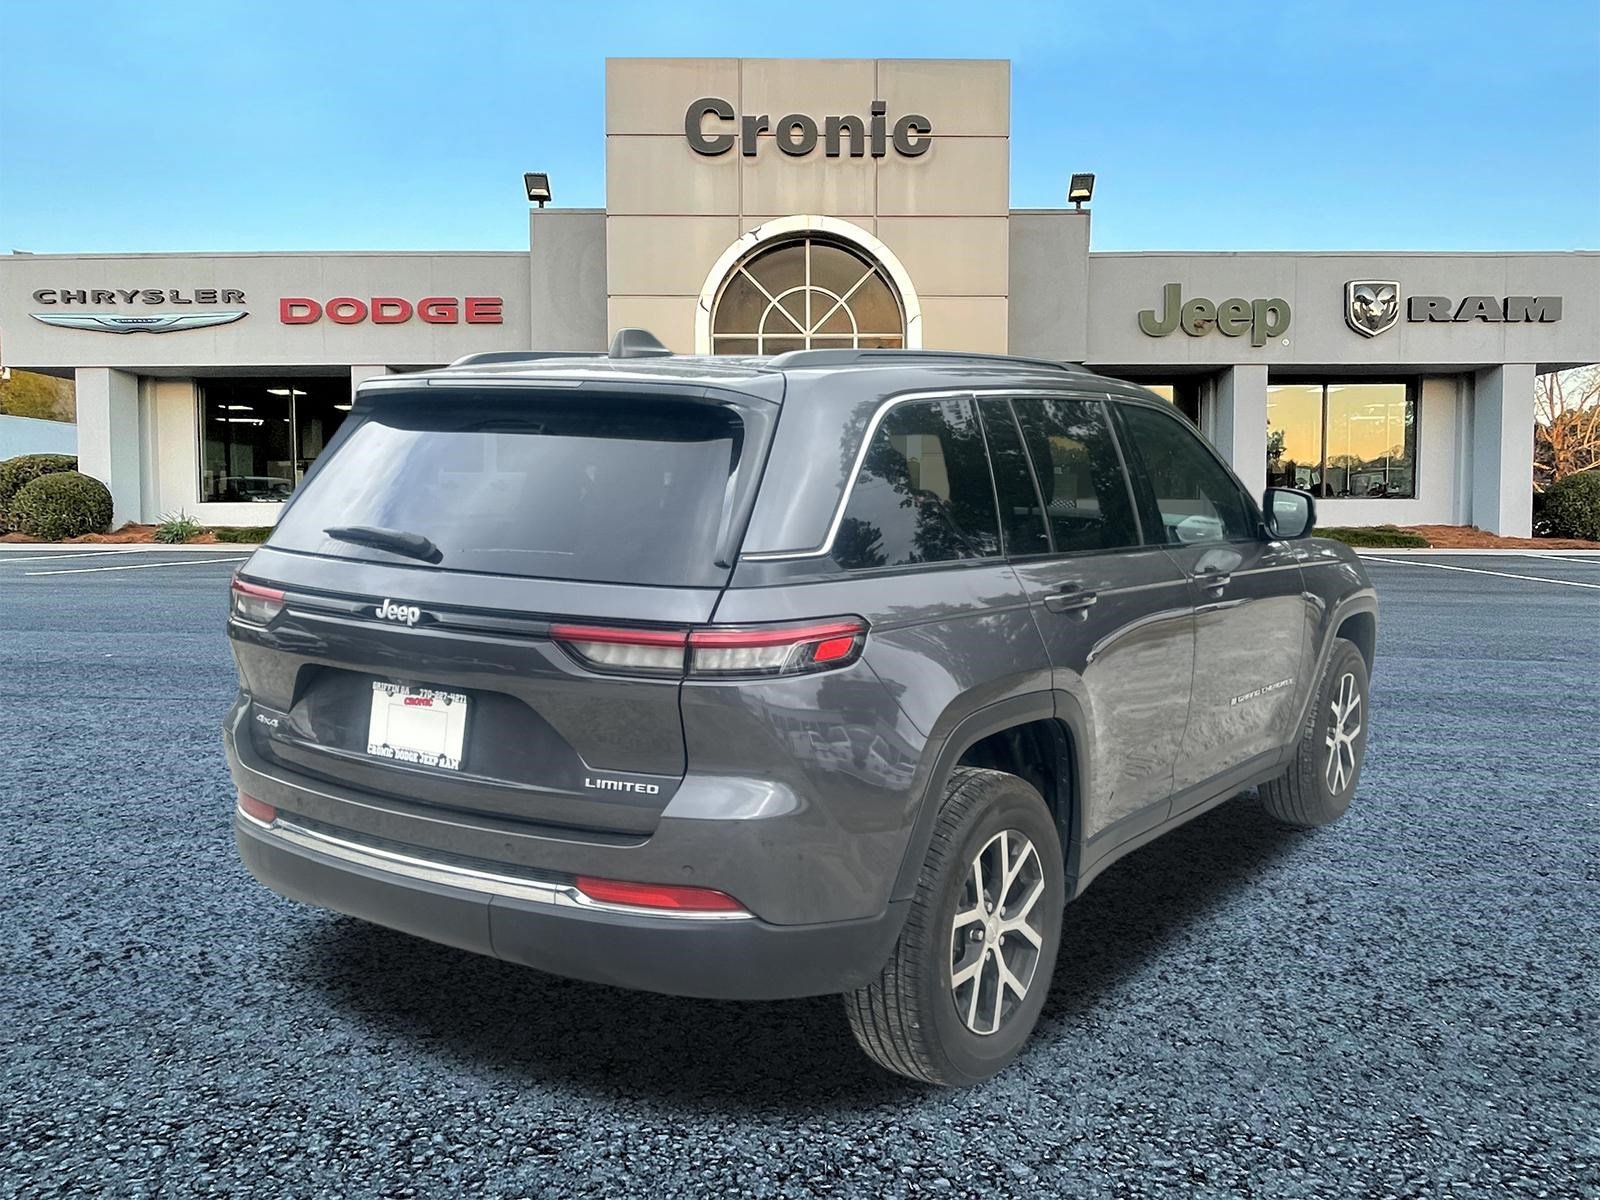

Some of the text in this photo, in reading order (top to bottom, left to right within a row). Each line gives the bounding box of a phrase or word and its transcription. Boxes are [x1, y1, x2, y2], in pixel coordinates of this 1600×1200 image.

[684, 97, 932, 157] Cronic
[32, 288, 246, 305] CHRYSLER
[279, 296, 503, 325] DODGE
[1407, 295, 1563, 323] RAM
[1138, 282, 1291, 347] Jeep
[375, 598, 420, 626] Jeep
[256, 713, 279, 728] 4x4
[584, 778, 660, 795] LIMITED
